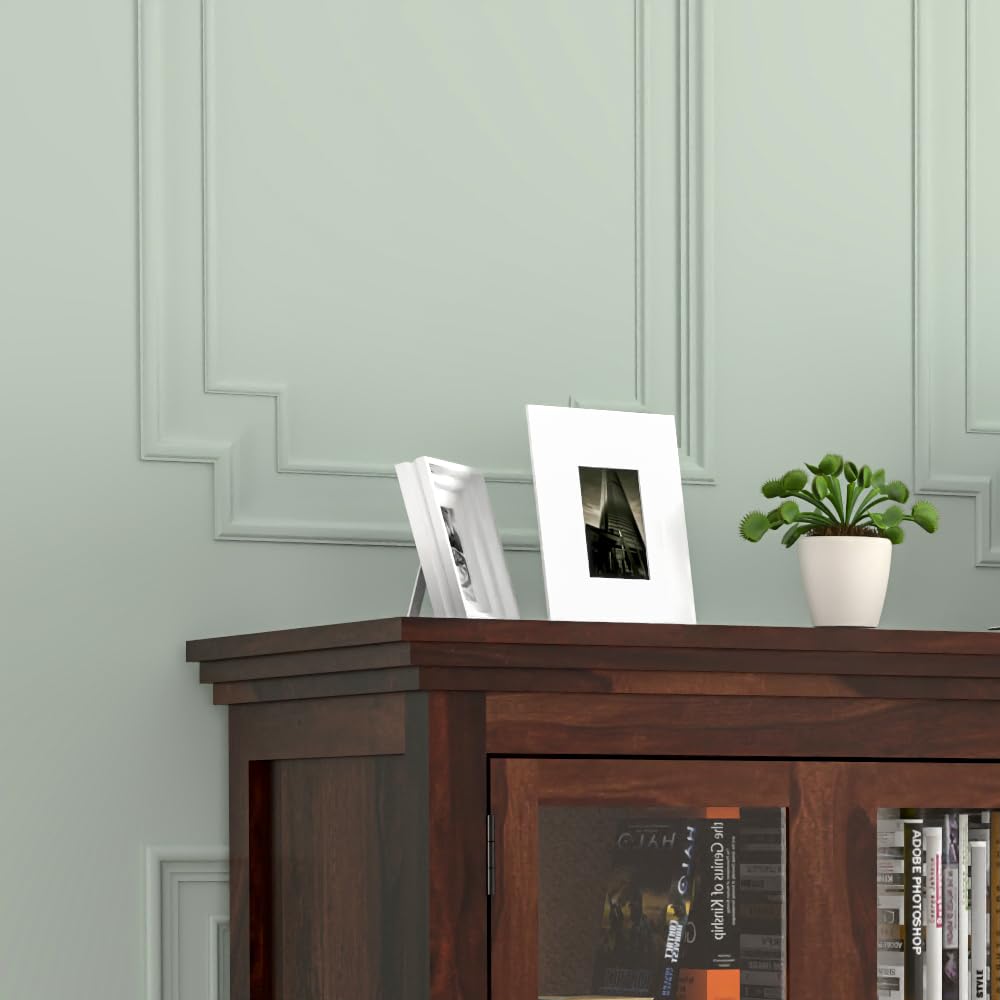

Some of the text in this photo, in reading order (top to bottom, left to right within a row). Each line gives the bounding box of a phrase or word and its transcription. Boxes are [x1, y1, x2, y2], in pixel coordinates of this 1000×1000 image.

[911, 829, 923, 956] ADOBE PHOTOSHOP
[976, 969, 984, 998] STYLE
